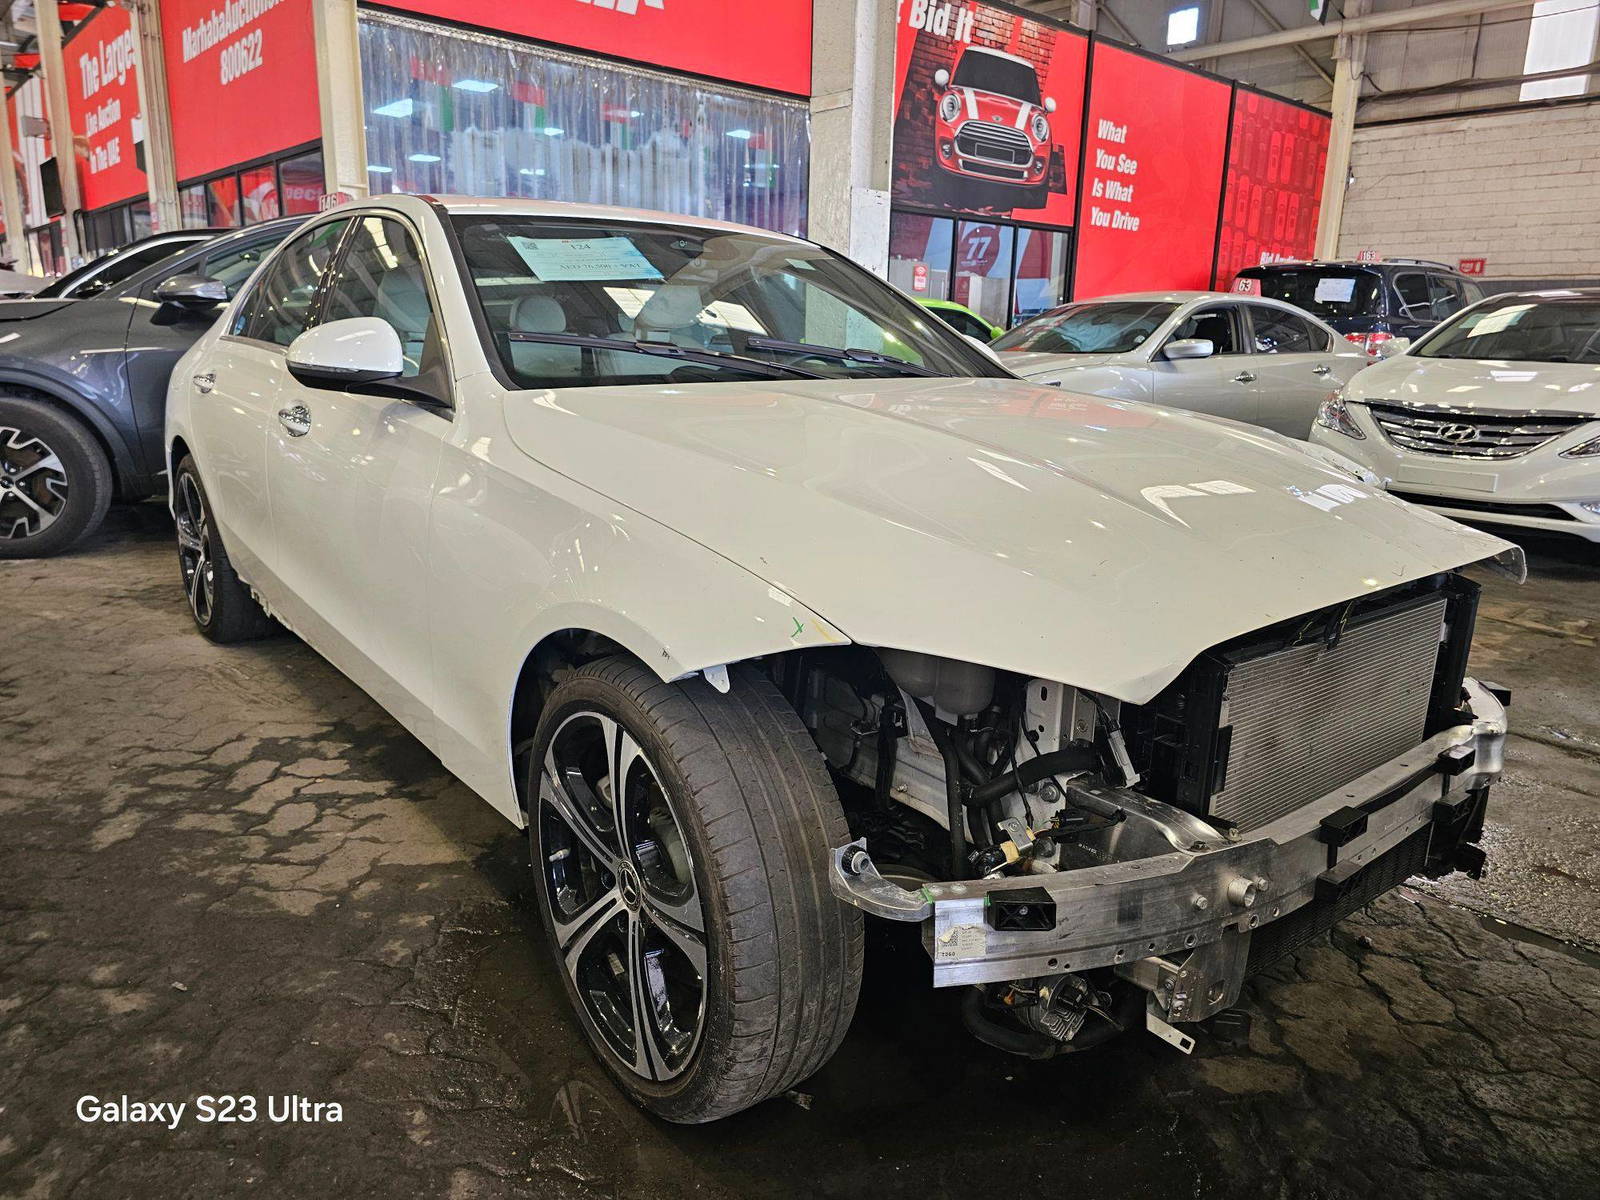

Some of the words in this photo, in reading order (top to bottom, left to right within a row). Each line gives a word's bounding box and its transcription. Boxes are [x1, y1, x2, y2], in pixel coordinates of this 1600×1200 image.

[909, 0, 951, 37] Bid
[955, 7, 975, 44] It
[221, 28, 263, 85] 800622
[79, 52, 100, 100] The
[1097, 118, 1127, 144] What
[1095, 148, 1117, 171] You
[1116, 153, 1138, 175] See
[1091, 177, 1105, 198] Is
[1104, 179, 1134, 203] What
[1090, 206, 1112, 227] You
[1111, 209, 1140, 231] Drive
[966, 236, 993, 260] 77
[1239, 279, 1252, 291] 63
